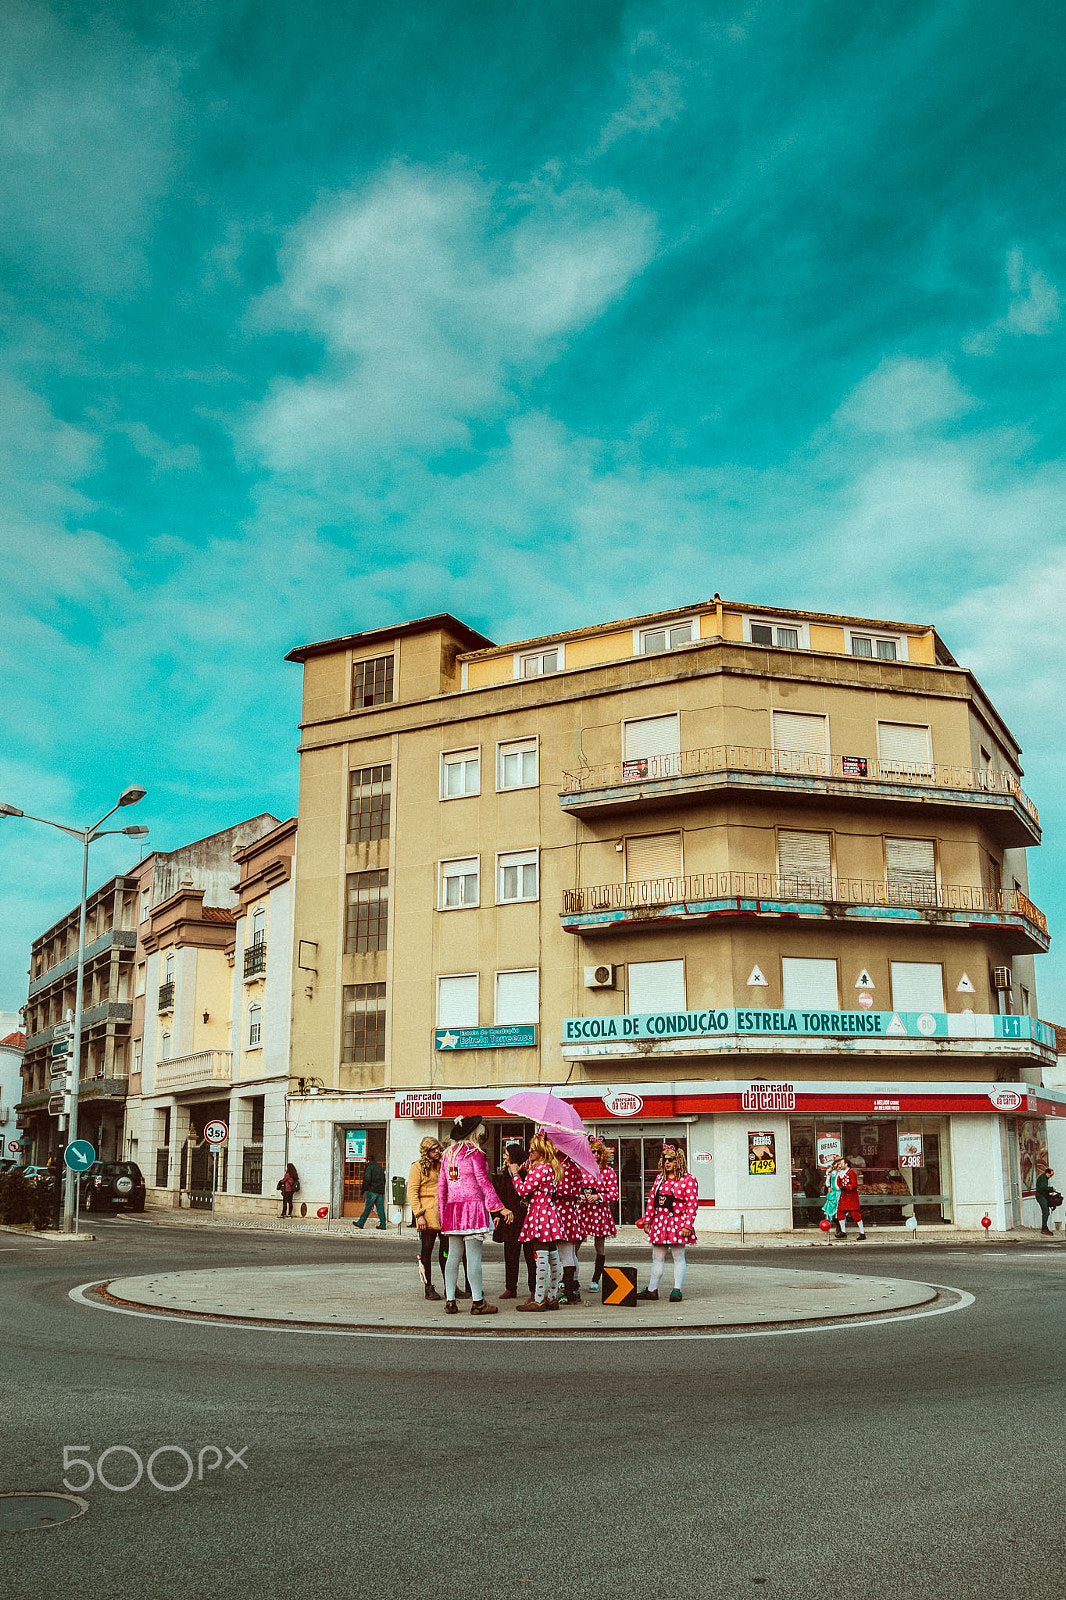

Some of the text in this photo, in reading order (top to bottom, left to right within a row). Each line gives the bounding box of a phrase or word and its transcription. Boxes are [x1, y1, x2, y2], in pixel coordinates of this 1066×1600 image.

[567, 1010, 882, 1039] ESCOLA DE CONDUÇÃO ESTRELA TORREENSE
[921, 1019, 932, 1030] 80
[751, 1083, 794, 1092] mercado
[406, 1092, 442, 1101] mercado
[743, 1090, 795, 1109] da carne
[400, 1099, 442, 1116] da carne
